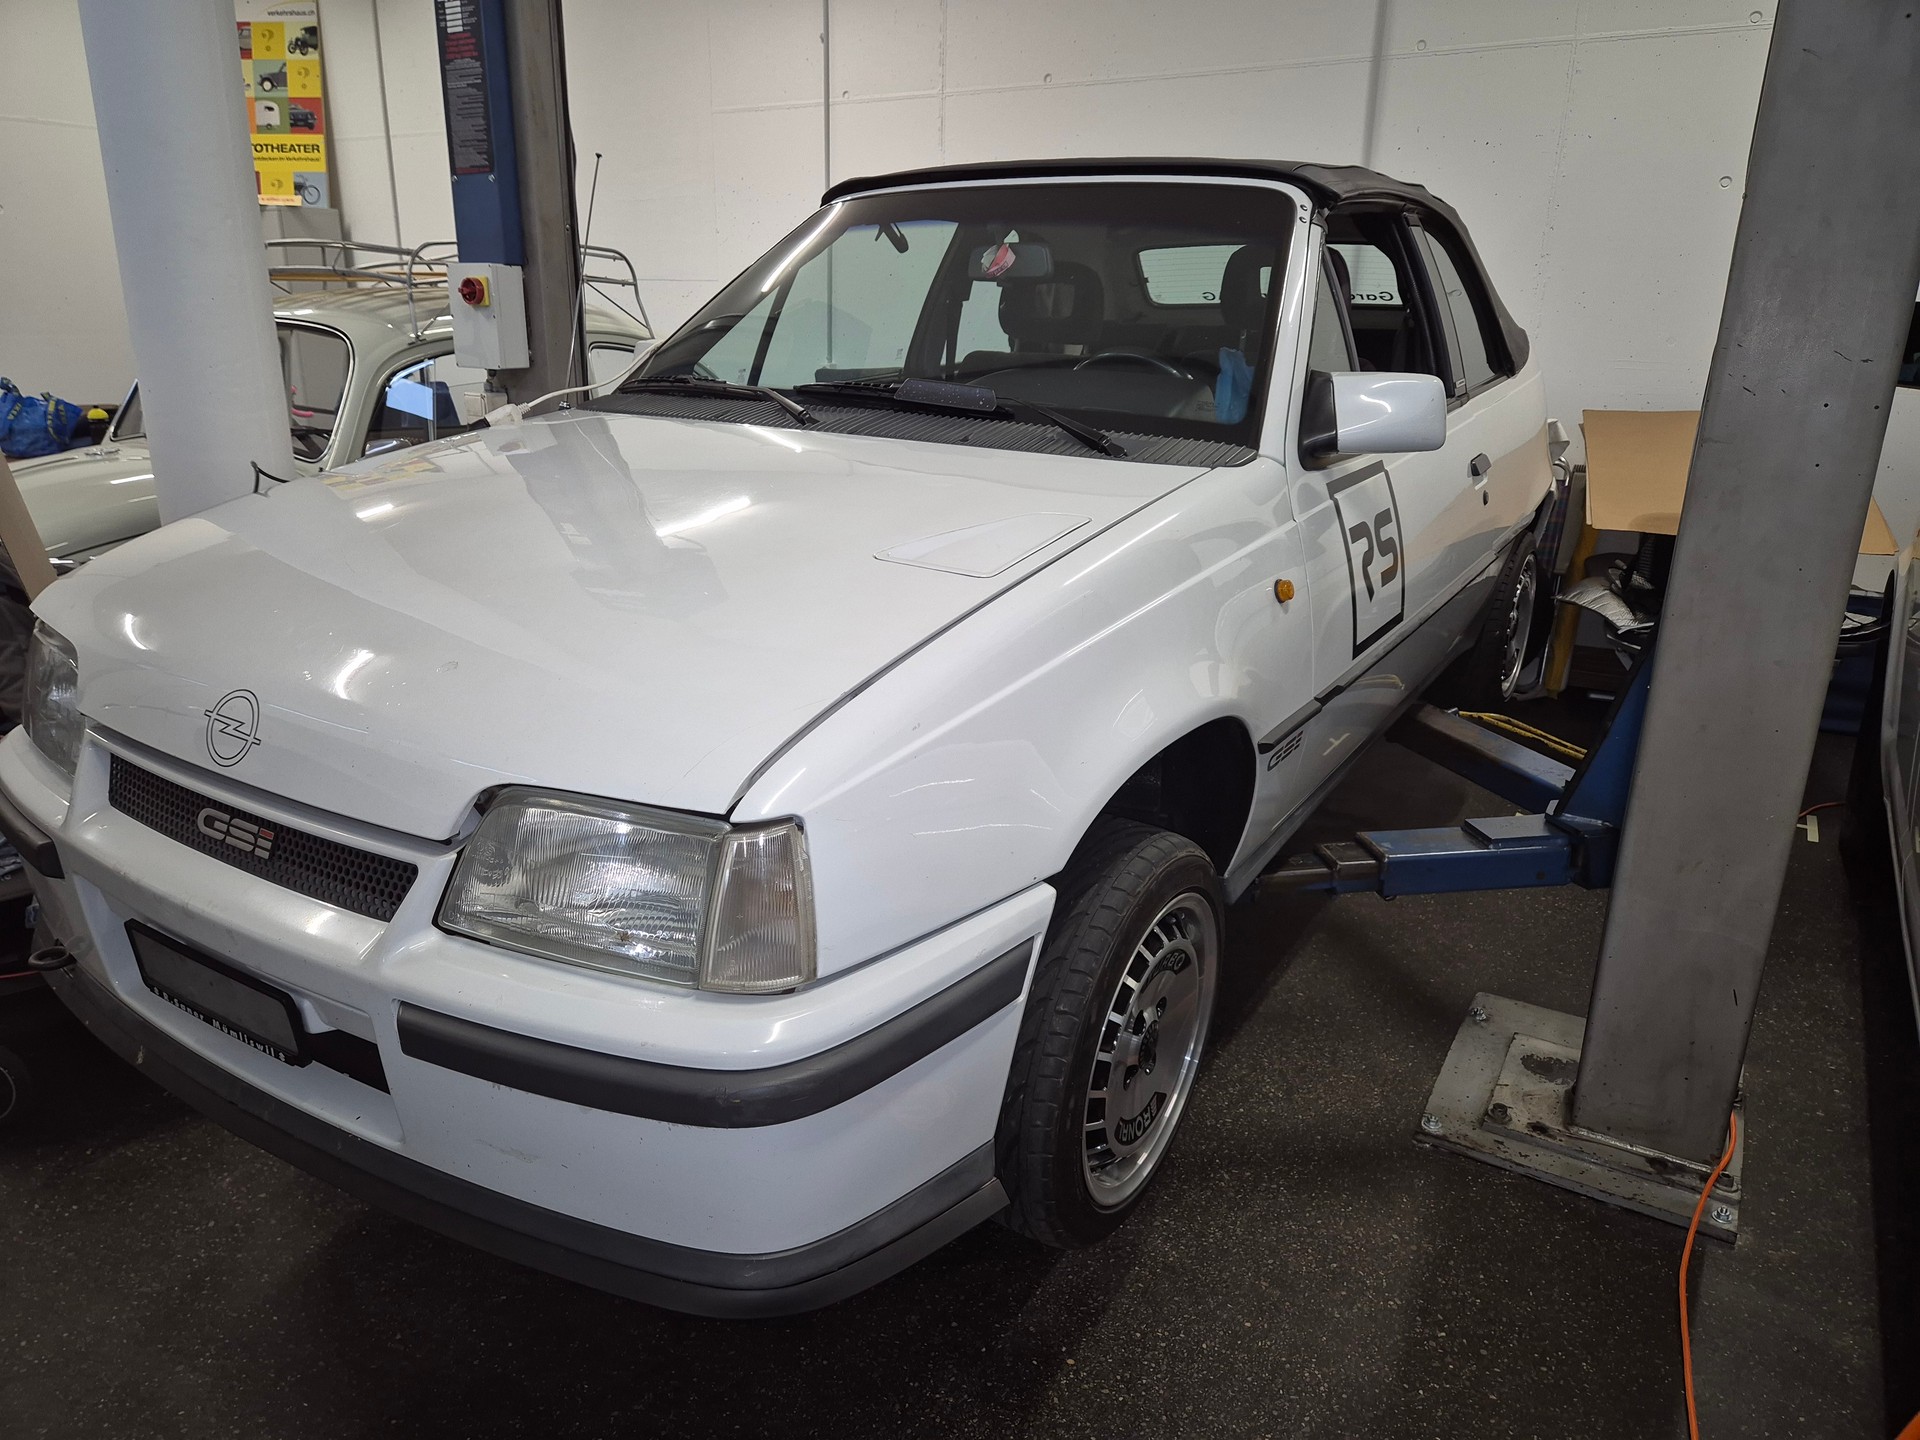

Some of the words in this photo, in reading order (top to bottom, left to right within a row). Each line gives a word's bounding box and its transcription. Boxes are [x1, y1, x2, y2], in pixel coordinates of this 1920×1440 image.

[266, 8, 316, 17] verkehrshaus.ch
[1348, 507, 1399, 603] RS
[212, 1018, 276, 1057] Mümliswil
[1119, 1106, 1152, 1142] RONAL
